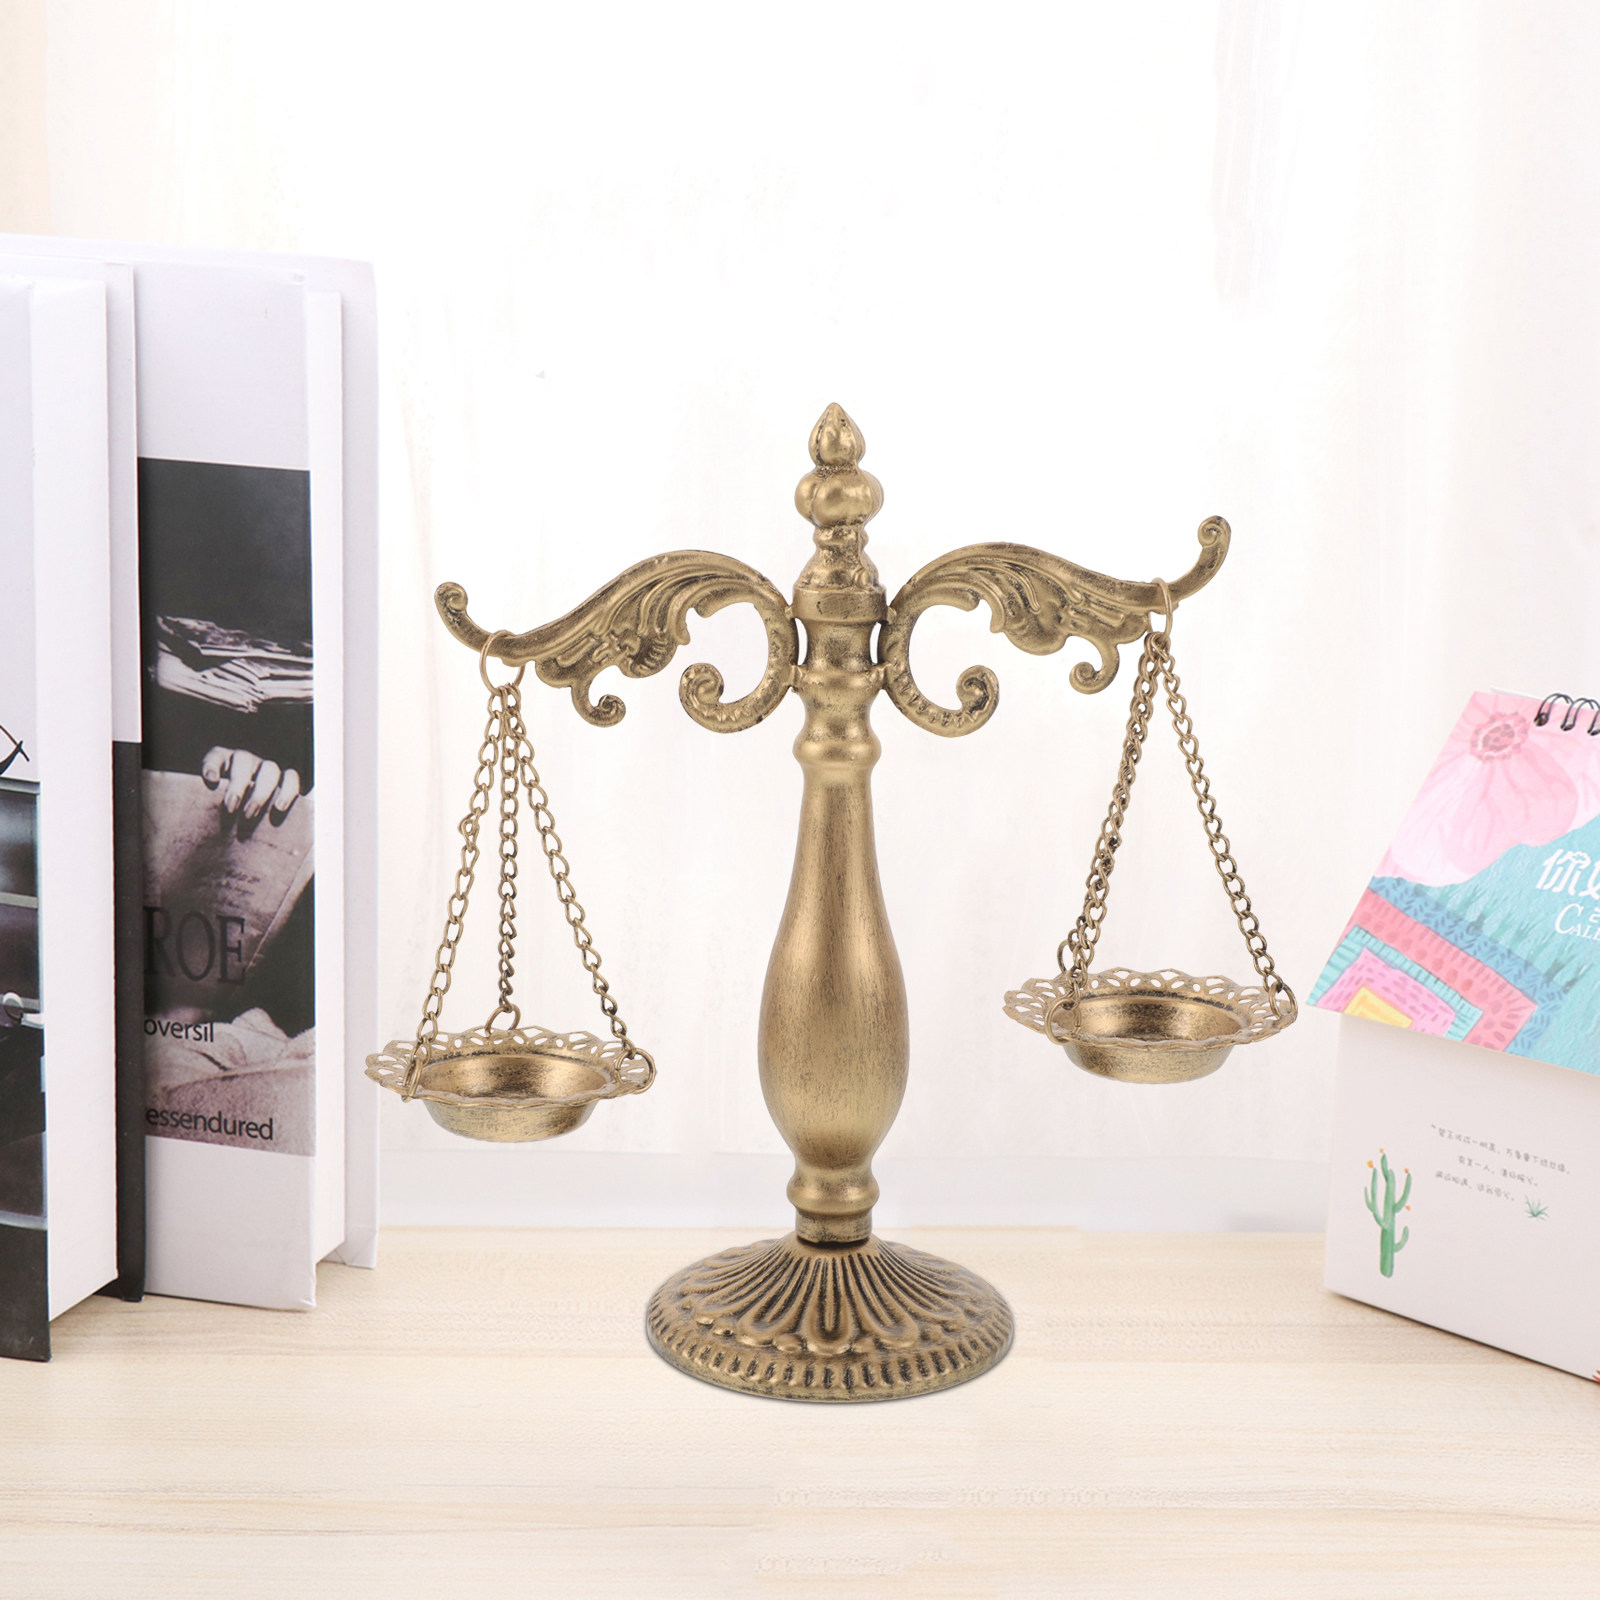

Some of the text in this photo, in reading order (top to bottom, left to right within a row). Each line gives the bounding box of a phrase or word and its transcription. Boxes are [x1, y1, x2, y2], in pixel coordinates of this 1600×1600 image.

[143, 906, 246, 985] ROE
[144, 1018, 214, 1043] oversil
[145, 1108, 273, 1141] essendured
